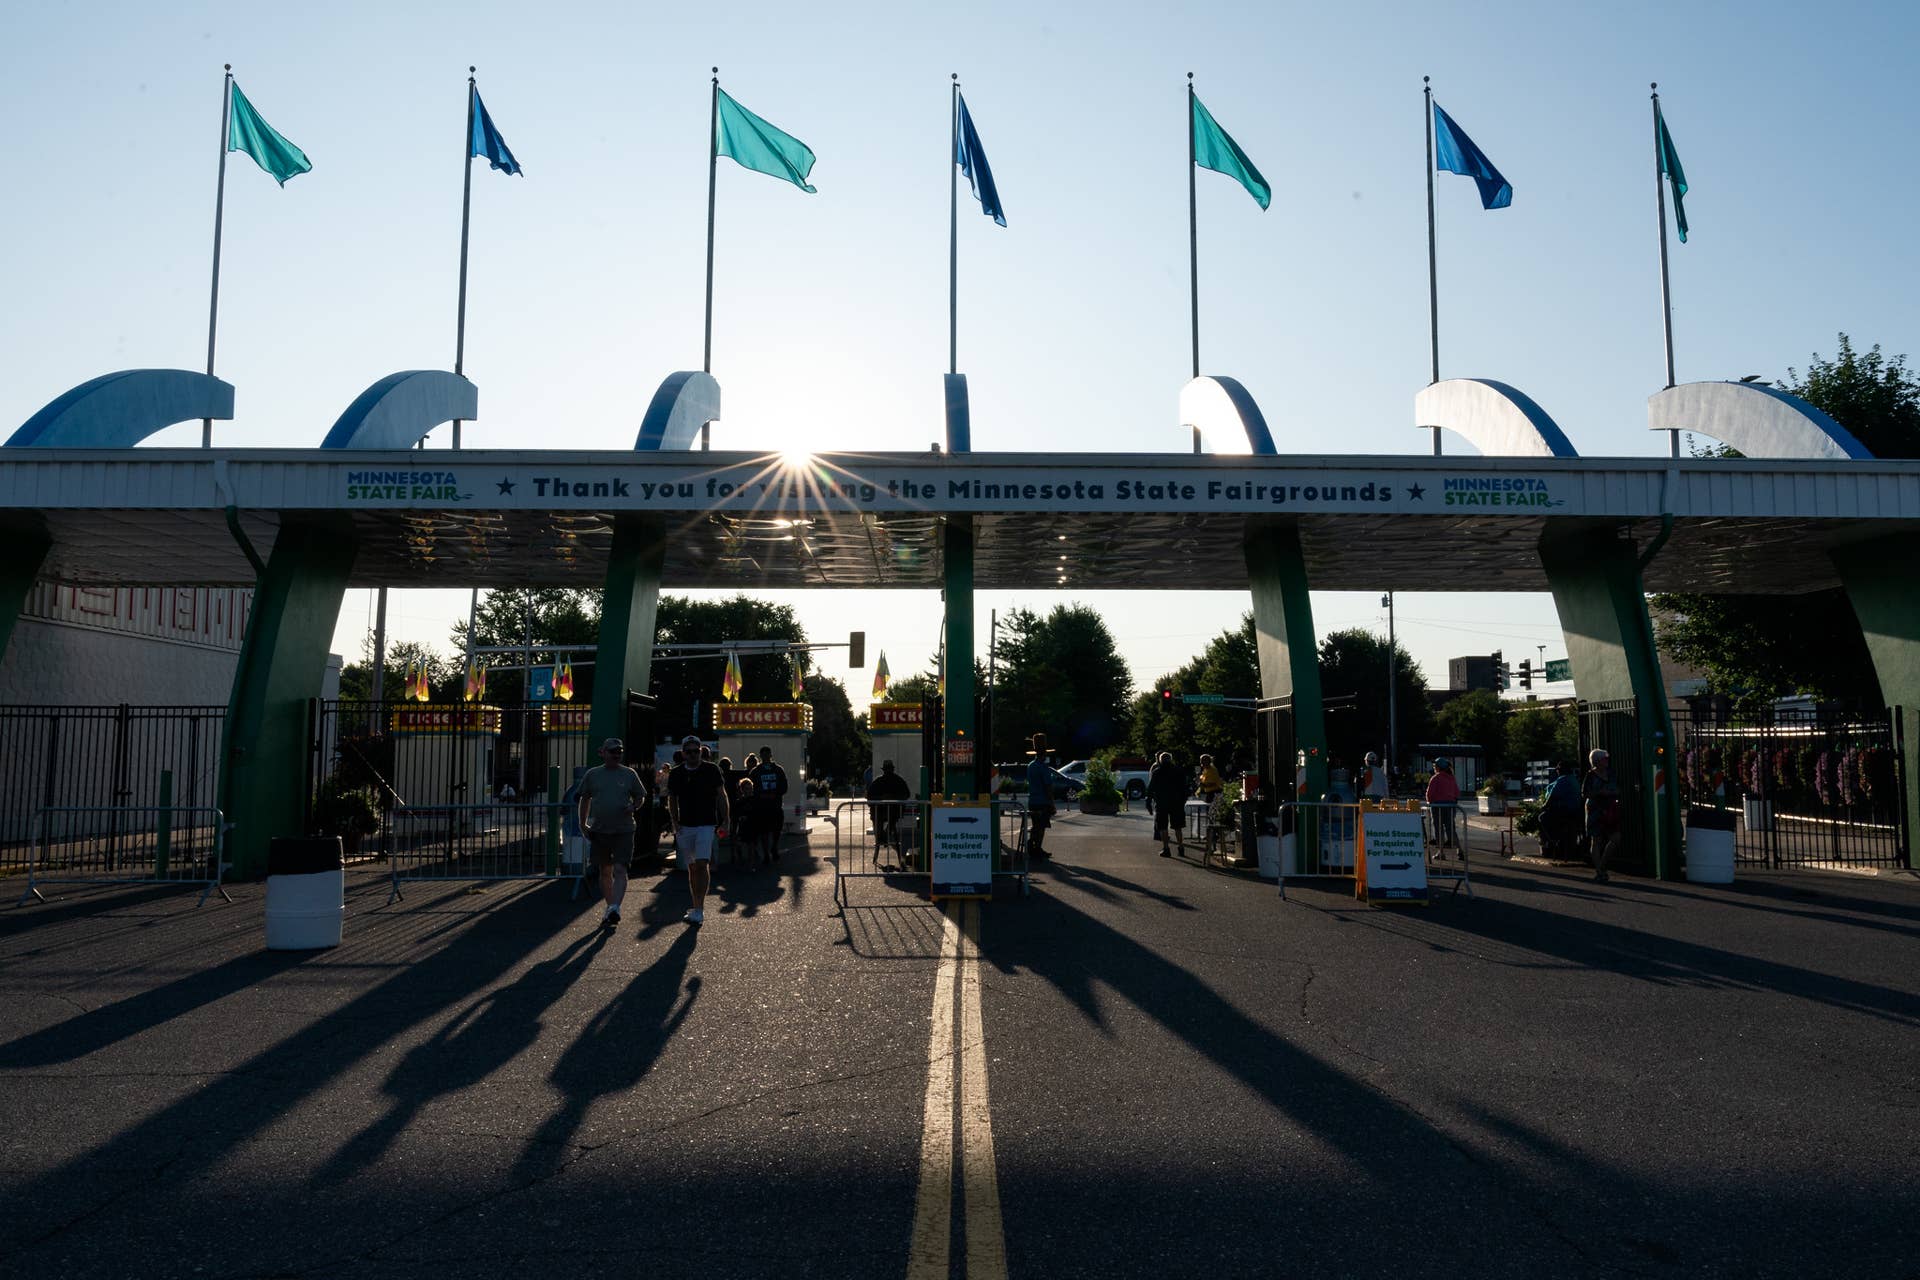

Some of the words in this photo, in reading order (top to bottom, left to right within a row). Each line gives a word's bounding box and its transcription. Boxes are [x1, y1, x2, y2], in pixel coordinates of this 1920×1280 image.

[348, 472, 457, 485] MINNESOTA
[533, 478, 629, 497] Thank
[641, 482, 694, 500] you
[706, 478, 746, 498] for
[887, 479, 936, 499] the
[949, 480, 1104, 500] Minnesota
[1116, 480, 1196, 500] State
[1207, 481, 1392, 504] Fairgrounds
[1444, 478, 1548, 492] MINNESOTA
[348, 486, 407, 500] STATE
[411, 486, 461, 501] FAIR
[1445, 492, 1501, 506] STATE
[1505, 492, 1551, 507] FAIR
[536, 685, 546, 697] 5
[408, 712, 470, 725] TICKES
[728, 711, 791, 722] TICKETS
[947, 740, 974, 752] KEEP
[947, 752, 974, 766] RIGHT
[934, 832, 958, 840] Hand
[960, 832, 989, 841] Stamp
[1366, 829, 1390, 838] Hand
[1391, 830, 1420, 839] Stamp
[941, 842, 982, 851] Required
[1373, 839, 1415, 848] Required
[934, 852, 948, 860] For
[950, 852, 990, 860] Re-entry
[1367, 849, 1381, 857] For
[1383, 849, 1423, 858] Re-entry
